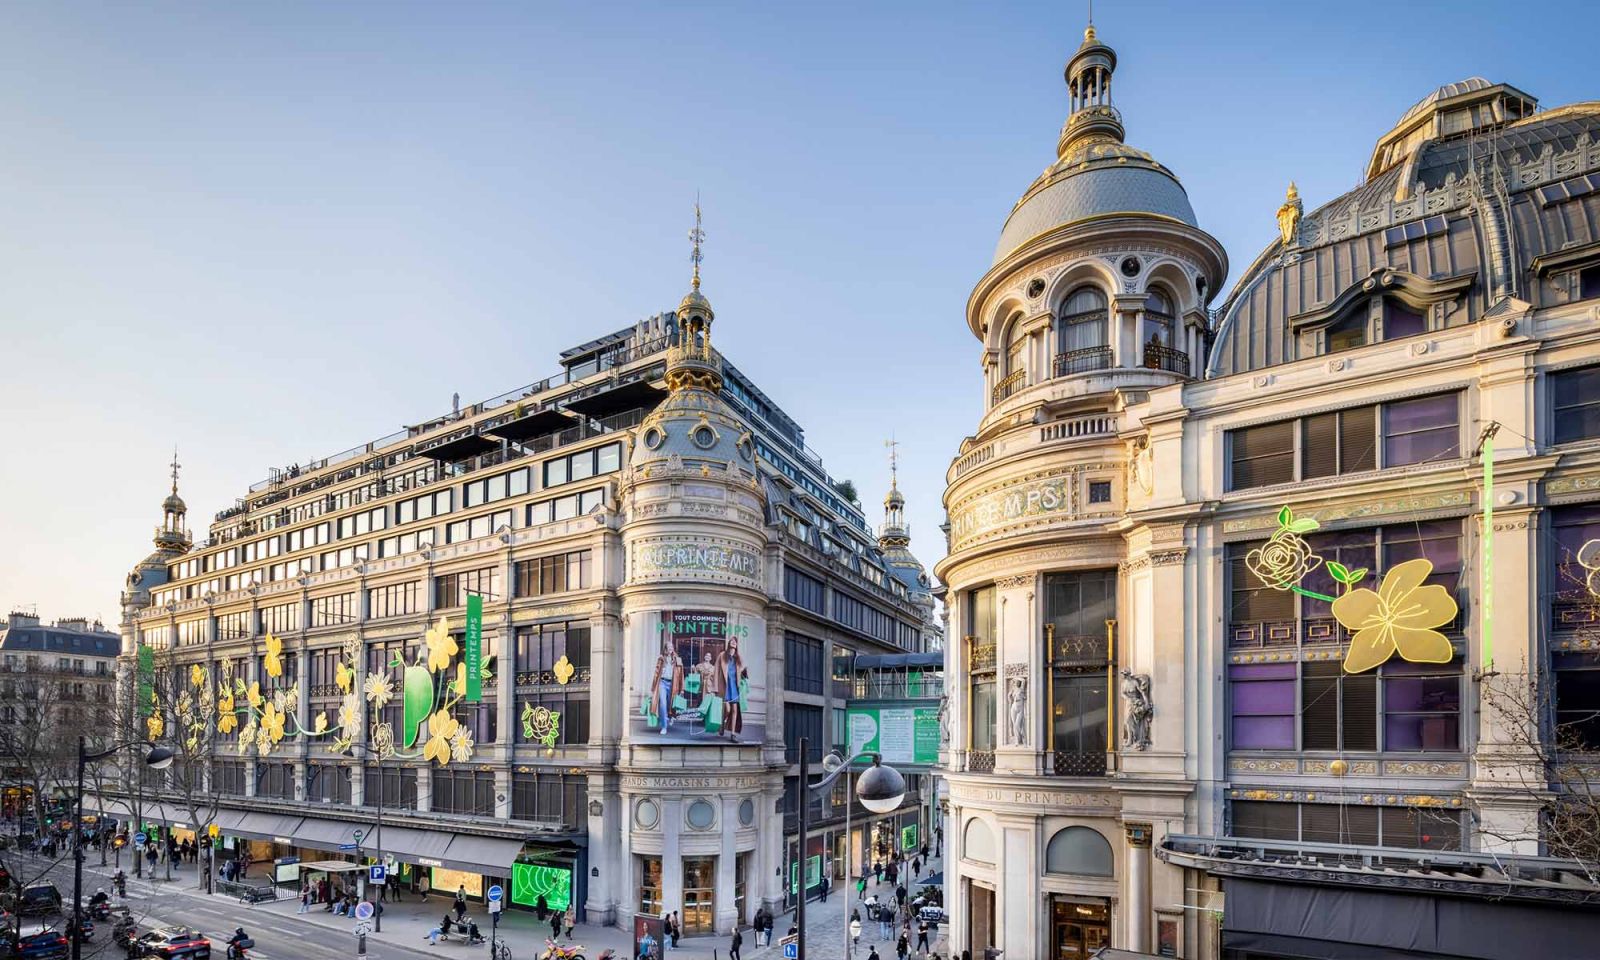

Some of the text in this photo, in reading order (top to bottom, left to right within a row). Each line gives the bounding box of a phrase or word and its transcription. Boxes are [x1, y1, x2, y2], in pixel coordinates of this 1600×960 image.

[666, 547, 754, 575] PRINTEMPS
[691, 615, 726, 623] COMMENCE
[656, 622, 749, 638] PRINTEMPS
[469, 617, 478, 680] PRINTEMPS
[653, 777, 710, 788] MAGASINS
[717, 777, 730, 787] DU
[987, 790, 1002, 801] DU
[1014, 791, 1112, 807] PRINTEMPS
[373, 867, 382, 878] P
